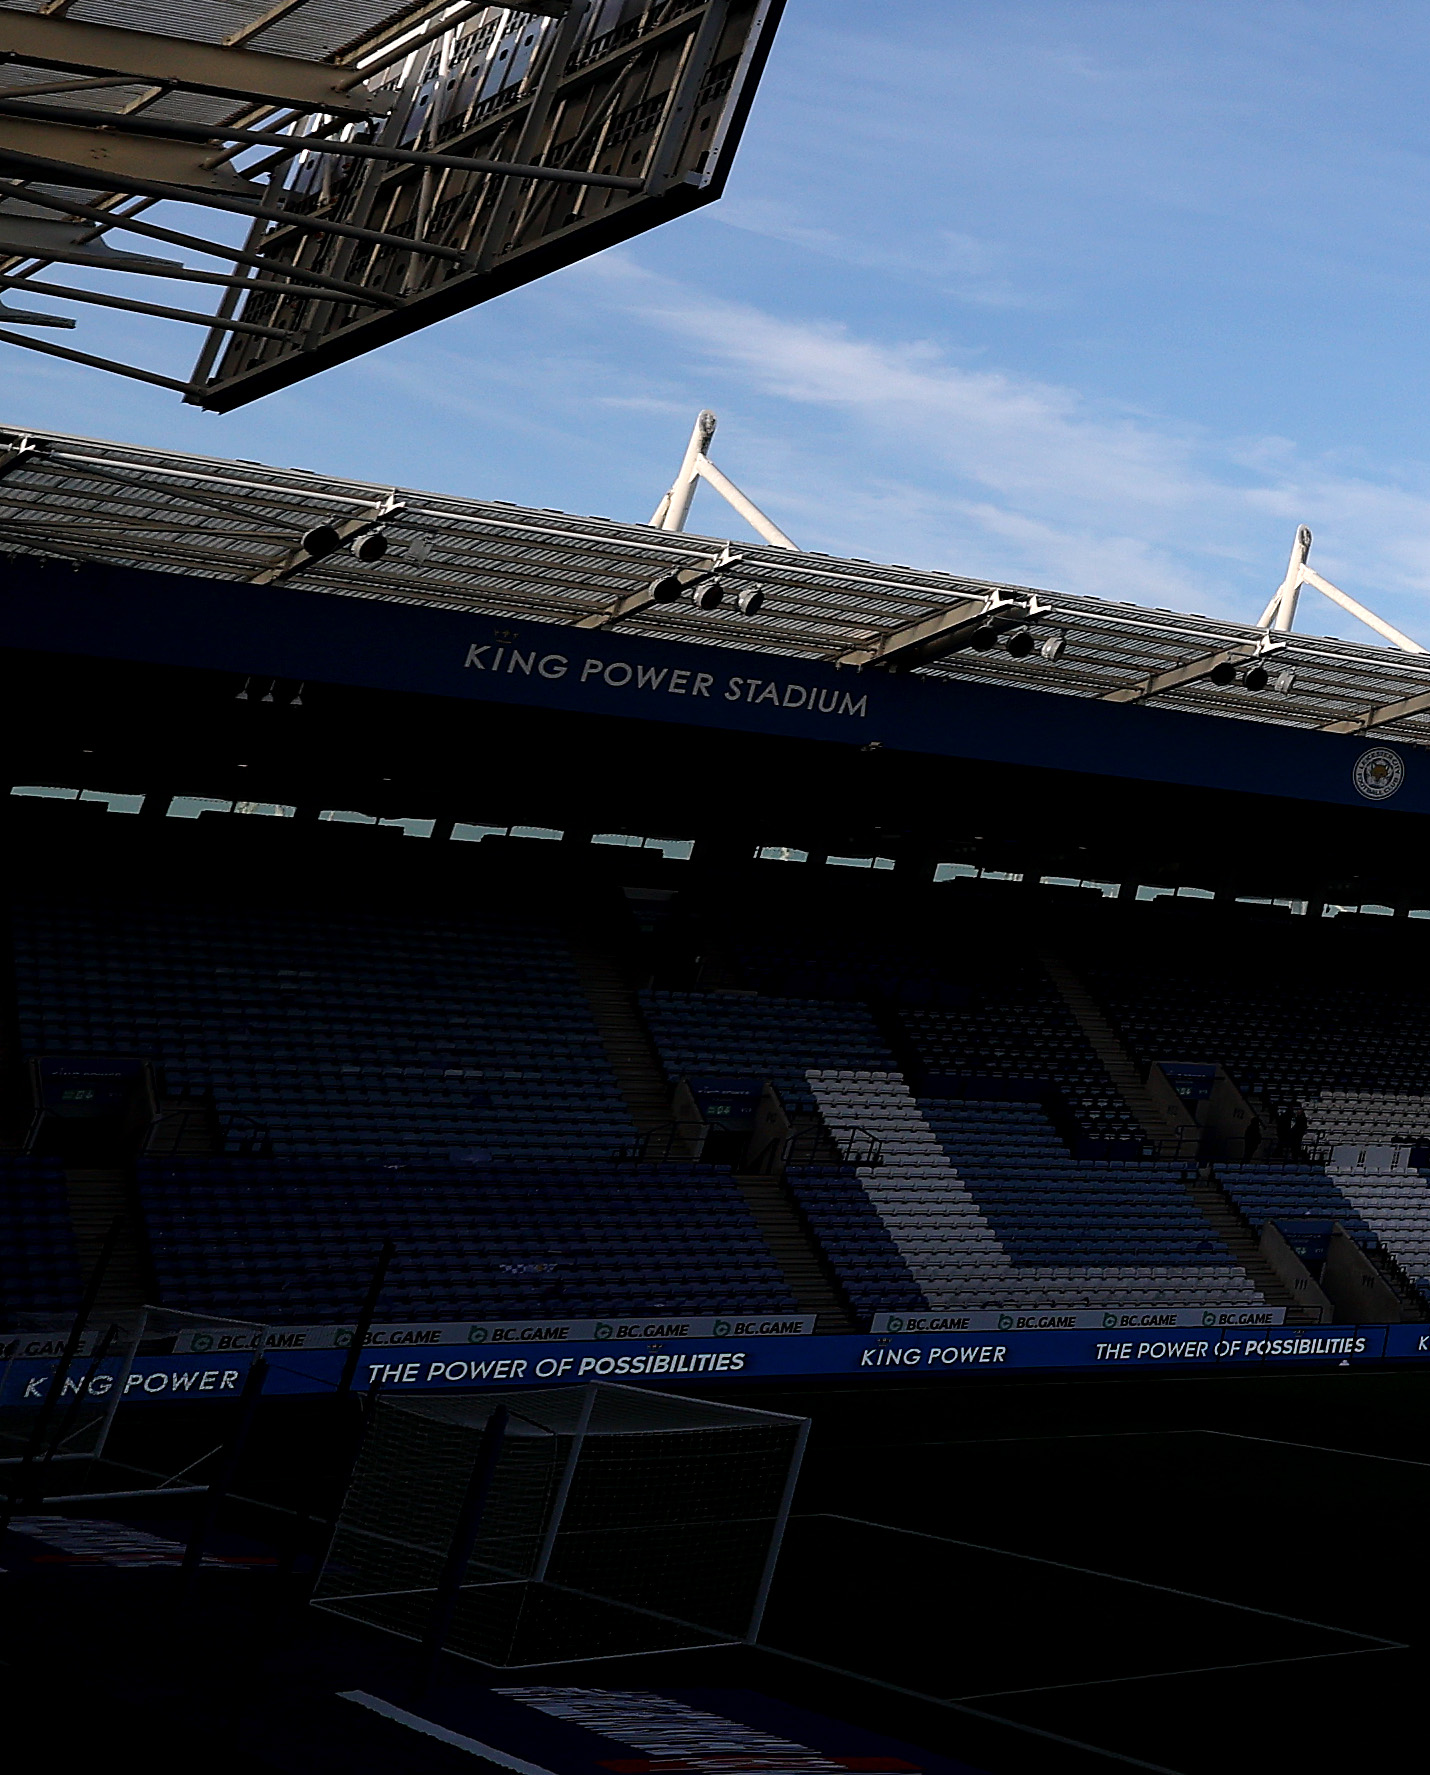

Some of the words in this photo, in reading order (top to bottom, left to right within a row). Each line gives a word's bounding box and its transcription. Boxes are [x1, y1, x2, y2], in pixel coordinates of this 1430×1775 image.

[463, 643, 569, 679] KING
[579, 658, 715, 698] POWER
[723, 676, 869, 718] STADIUM
[906, 1317, 971, 1331] BC.GAME
[1015, 1315, 1077, 1329] BC.GAME
[1119, 1313, 1177, 1327] BC.GAME
[1218, 1313, 1274, 1325] BC.GAME
[491, 1326, 570, 1342] BC.GAME
[615, 1323, 690, 1339] BC.GAME
[733, 1320, 804, 1336] BC.GAME
[361, 1330, 442, 1346] BC.GAME
[860, 1346, 922, 1367] KING
[927, 1345, 1009, 1365] POWER
[1095, 1342, 1133, 1361] THE
[1137, 1340, 1209, 1359] POWER
[1214, 1339, 1242, 1357] OF
[1244, 1337, 1367, 1356] POSSIBILITIES
[368, 1362, 422, 1384] THE
[425, 1359, 528, 1382] POWER
[535, 1357, 574, 1378] OF
[577, 1351, 747, 1377] POSSIBILITIES
[23, 1374, 114, 1400] KNG
[122, 1370, 240, 1396] POWER
